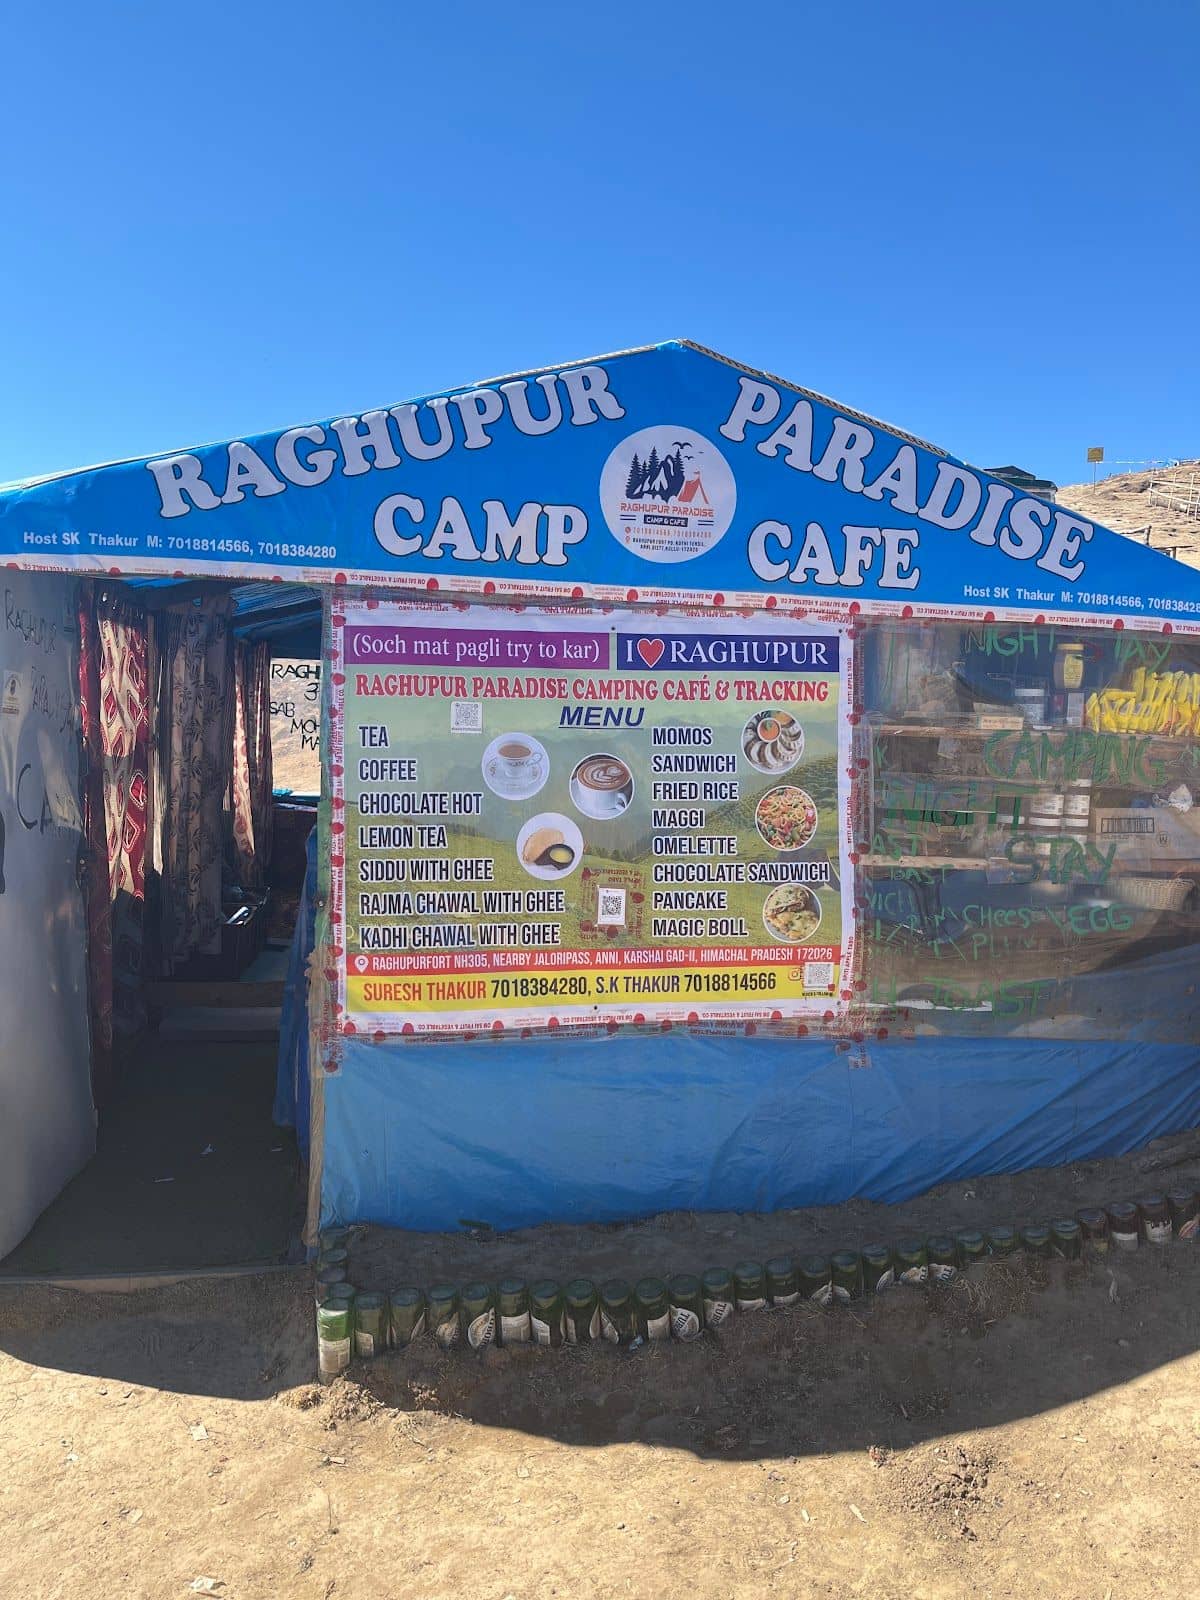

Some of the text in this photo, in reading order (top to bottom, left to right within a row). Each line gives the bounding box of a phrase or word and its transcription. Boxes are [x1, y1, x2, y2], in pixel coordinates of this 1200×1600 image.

[146, 365, 1094, 583] RAGHUPUR PARADISE
[620, 502, 715, 518] RAGHUPUR PARADISE
[374, 493, 589, 566] CAMP
[23, 532, 337, 559] Host SK Thakur M: 7018814566, 7018384280
[747, 519, 921, 590] CAFE
[964, 585, 990, 597] Host
[993, 587, 1009, 599] SK
[1016, 588, 1055, 602] Thakur
[1061, 591, 1073, 603] M:
[1077, 592, 1145, 609] 7018814566,
[353, 632, 600, 663] (Soch mat pagli try to kar)
[626, 639, 829, 665] I RAGHUPUR
[355, 674, 829, 702] RAGHUPUR PARADISE CAMPING CAFÉ & TRACKING
[559, 706, 645, 727] MENU
[359, 726, 389, 747] TEA
[653, 727, 712, 745] MOMOS
[359, 759, 417, 781] COFFEE
[653, 755, 736, 773] SANDWICH
[653, 782, 739, 800] FRIED RICE
[359, 793, 482, 814] CHOCOLATE HOT
[653, 809, 704, 827] MAGGI
[359, 826, 447, 848] LEMON TEA
[653, 837, 736, 855] OMELETTE
[359, 859, 493, 881] SIDDU WITH GHEE
[653, 864, 745, 882] CHOCOLATE
[748, 863, 829, 881] SANDWICH
[360, 891, 565, 915] RAJMA CHAWAL WITH GHEE
[653, 892, 727, 909] PANCAKE
[361, 927, 407, 948] KADHI
[412, 925, 475, 947] CHAWAL
[479, 925, 517, 945] WITH
[521, 924, 560, 944] GHEE
[653, 919, 704, 936] MAGIC
[708, 919, 748, 936] BOLL
[372, 955, 451, 971] RAGHUPURFORT
[454, 953, 491, 969] NH305,
[493, 952, 531, 967] NEARBY
[535, 951, 593, 966] JALORIPASS,
[595, 951, 622, 965] ANNI,
[623, 950, 664, 964] KARSHAI
[700, 948, 748, 963] HIMACHAL
[751, 948, 793, 962] PRADESH
[363, 972, 777, 1001] SURESH THAKUR 7018384280, S.K THAKUR 7018814566
